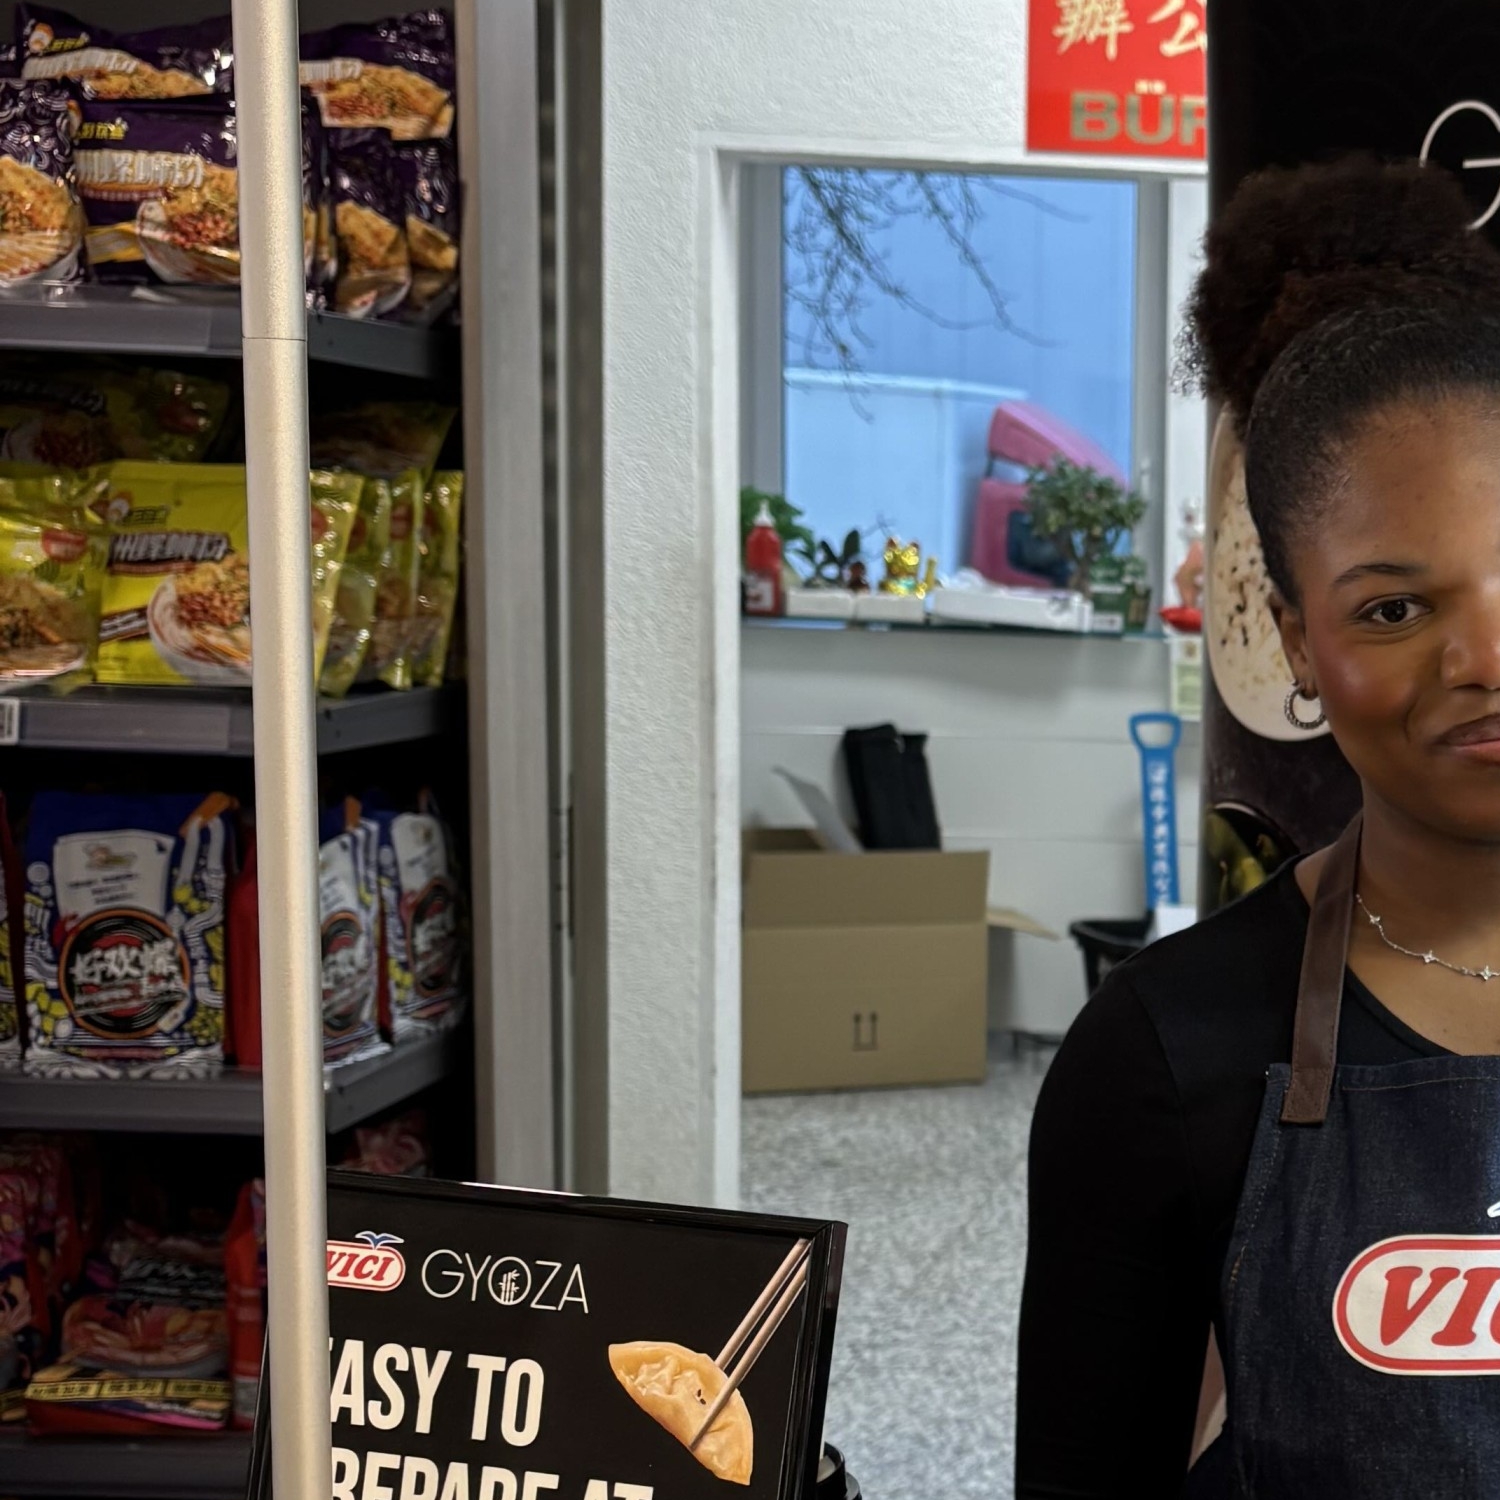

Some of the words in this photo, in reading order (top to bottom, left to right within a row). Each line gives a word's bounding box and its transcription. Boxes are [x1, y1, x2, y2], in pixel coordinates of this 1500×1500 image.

[421, 1249, 589, 1314] GYOZA
[329, 1337, 453, 1434] ASY
[467, 1353, 545, 1447] TO
